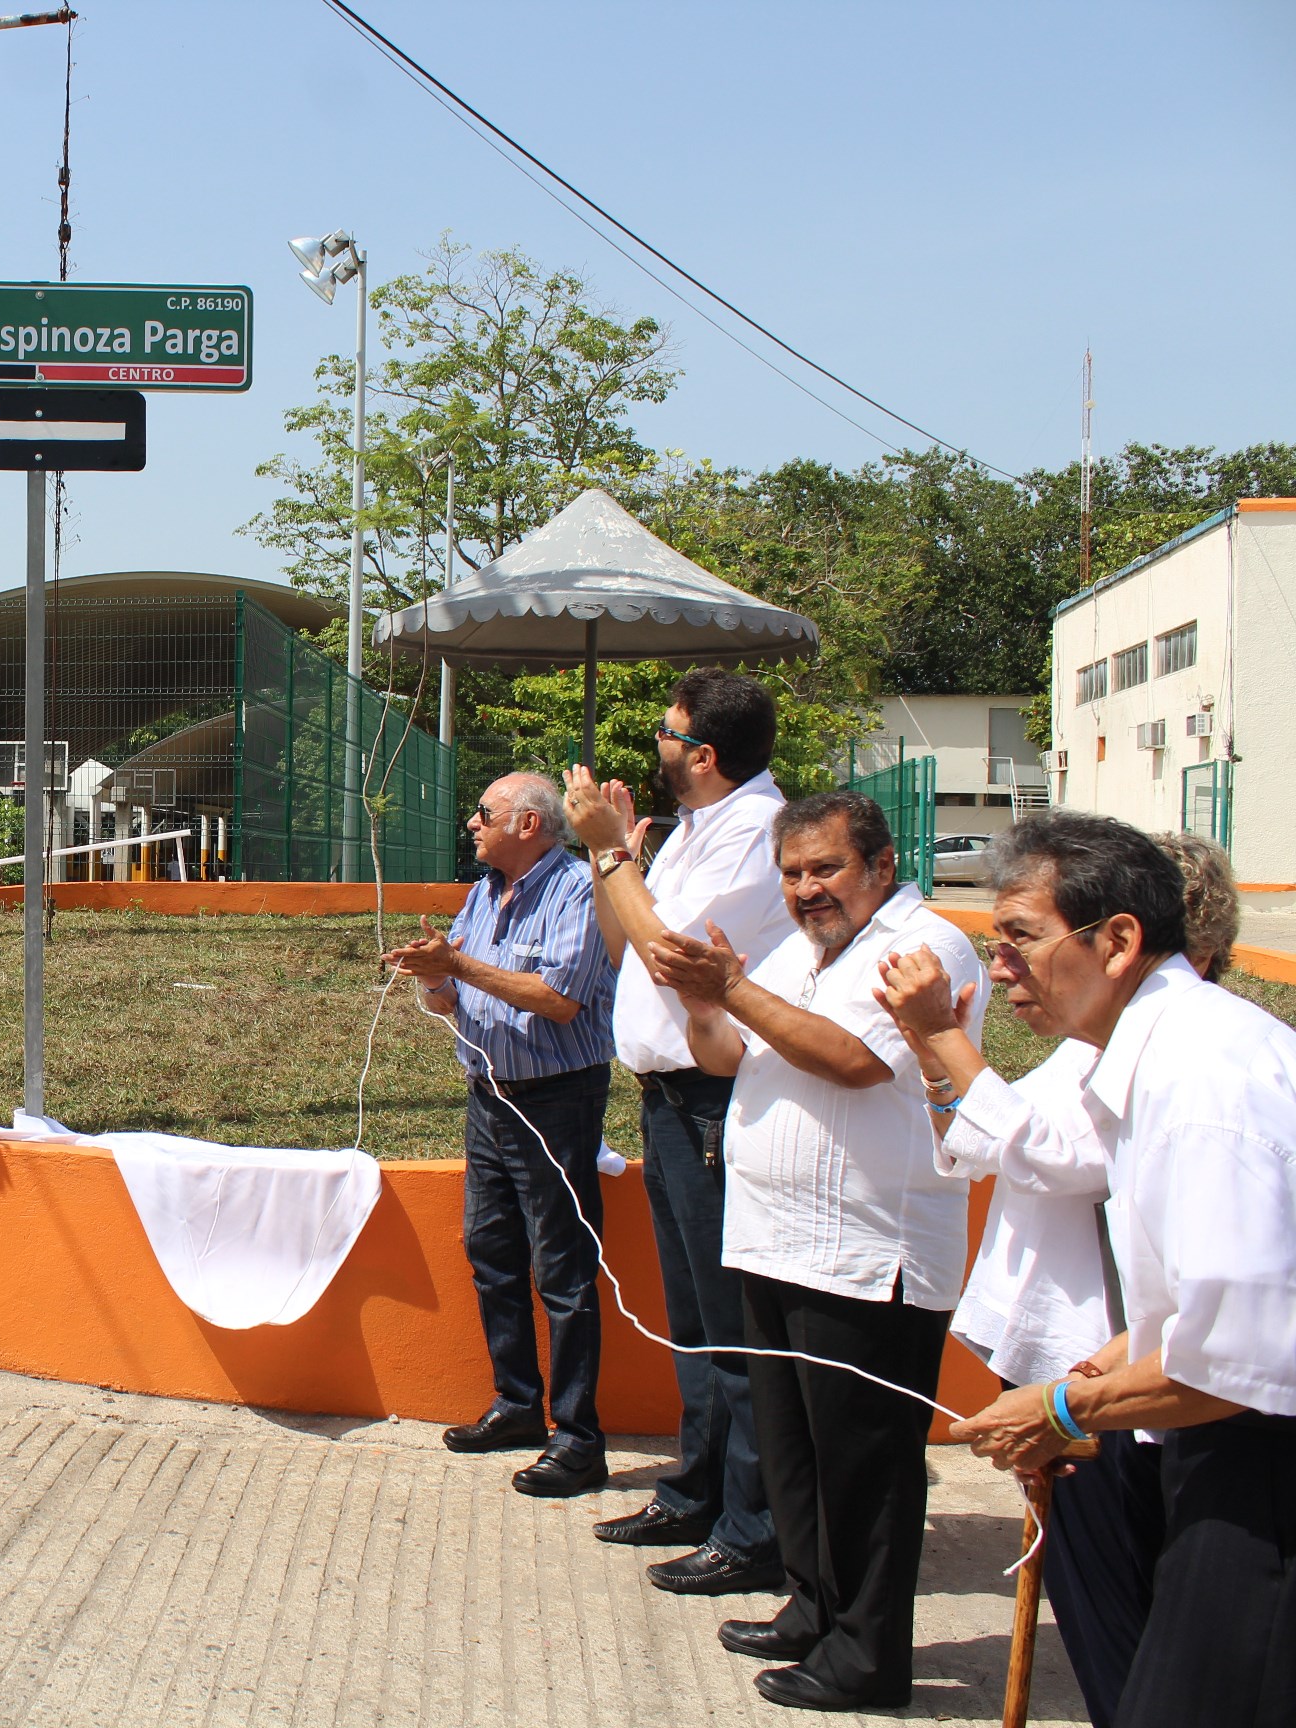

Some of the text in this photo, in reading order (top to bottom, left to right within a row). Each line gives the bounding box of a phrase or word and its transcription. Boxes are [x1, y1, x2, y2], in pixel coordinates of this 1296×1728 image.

[166, 297, 242, 311] C.P. 86190
[144, 320, 239, 364] Parga
[108, 367, 175, 381] CENTRO
